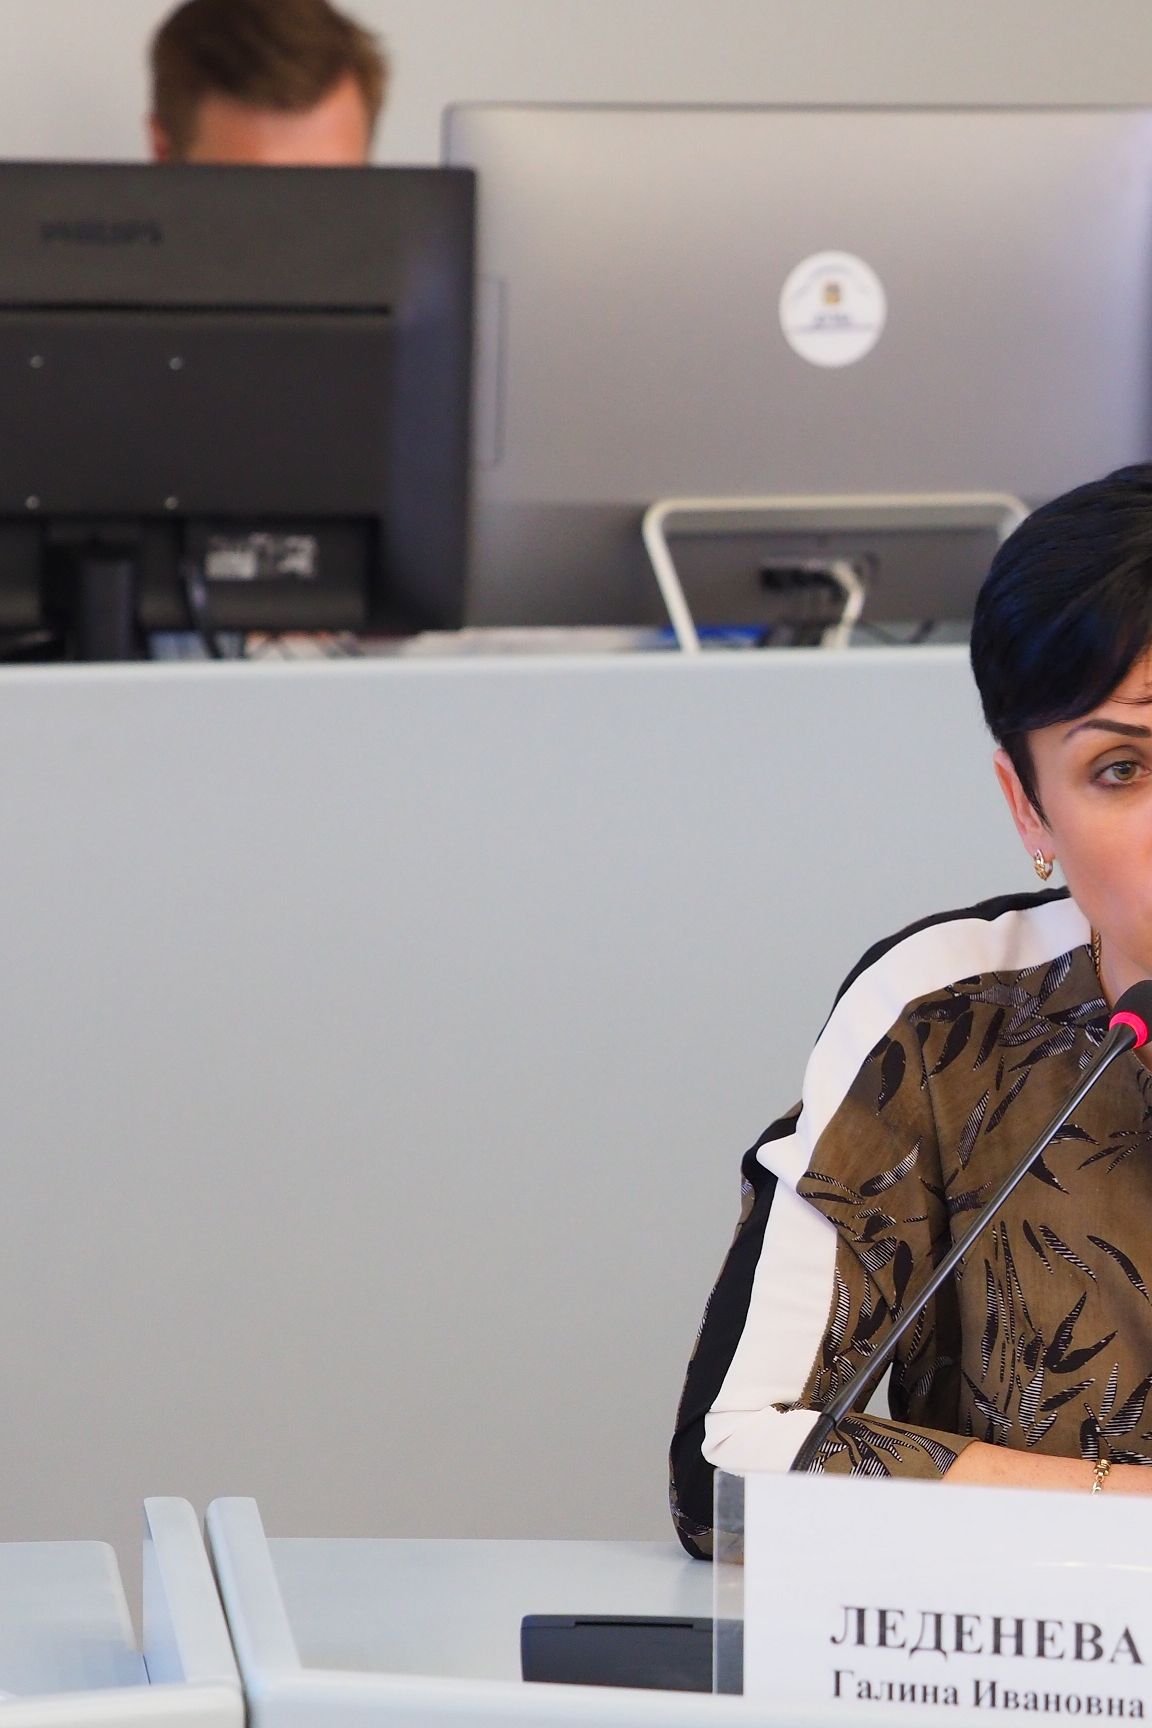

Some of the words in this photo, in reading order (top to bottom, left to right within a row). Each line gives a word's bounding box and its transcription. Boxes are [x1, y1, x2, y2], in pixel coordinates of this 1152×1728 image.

[830, 1605, 1146, 1667] ЛЕДЕНЕВА
[832, 1669, 960, 1707] Галина
[972, 1679, 1146, 1720] Ивановна
